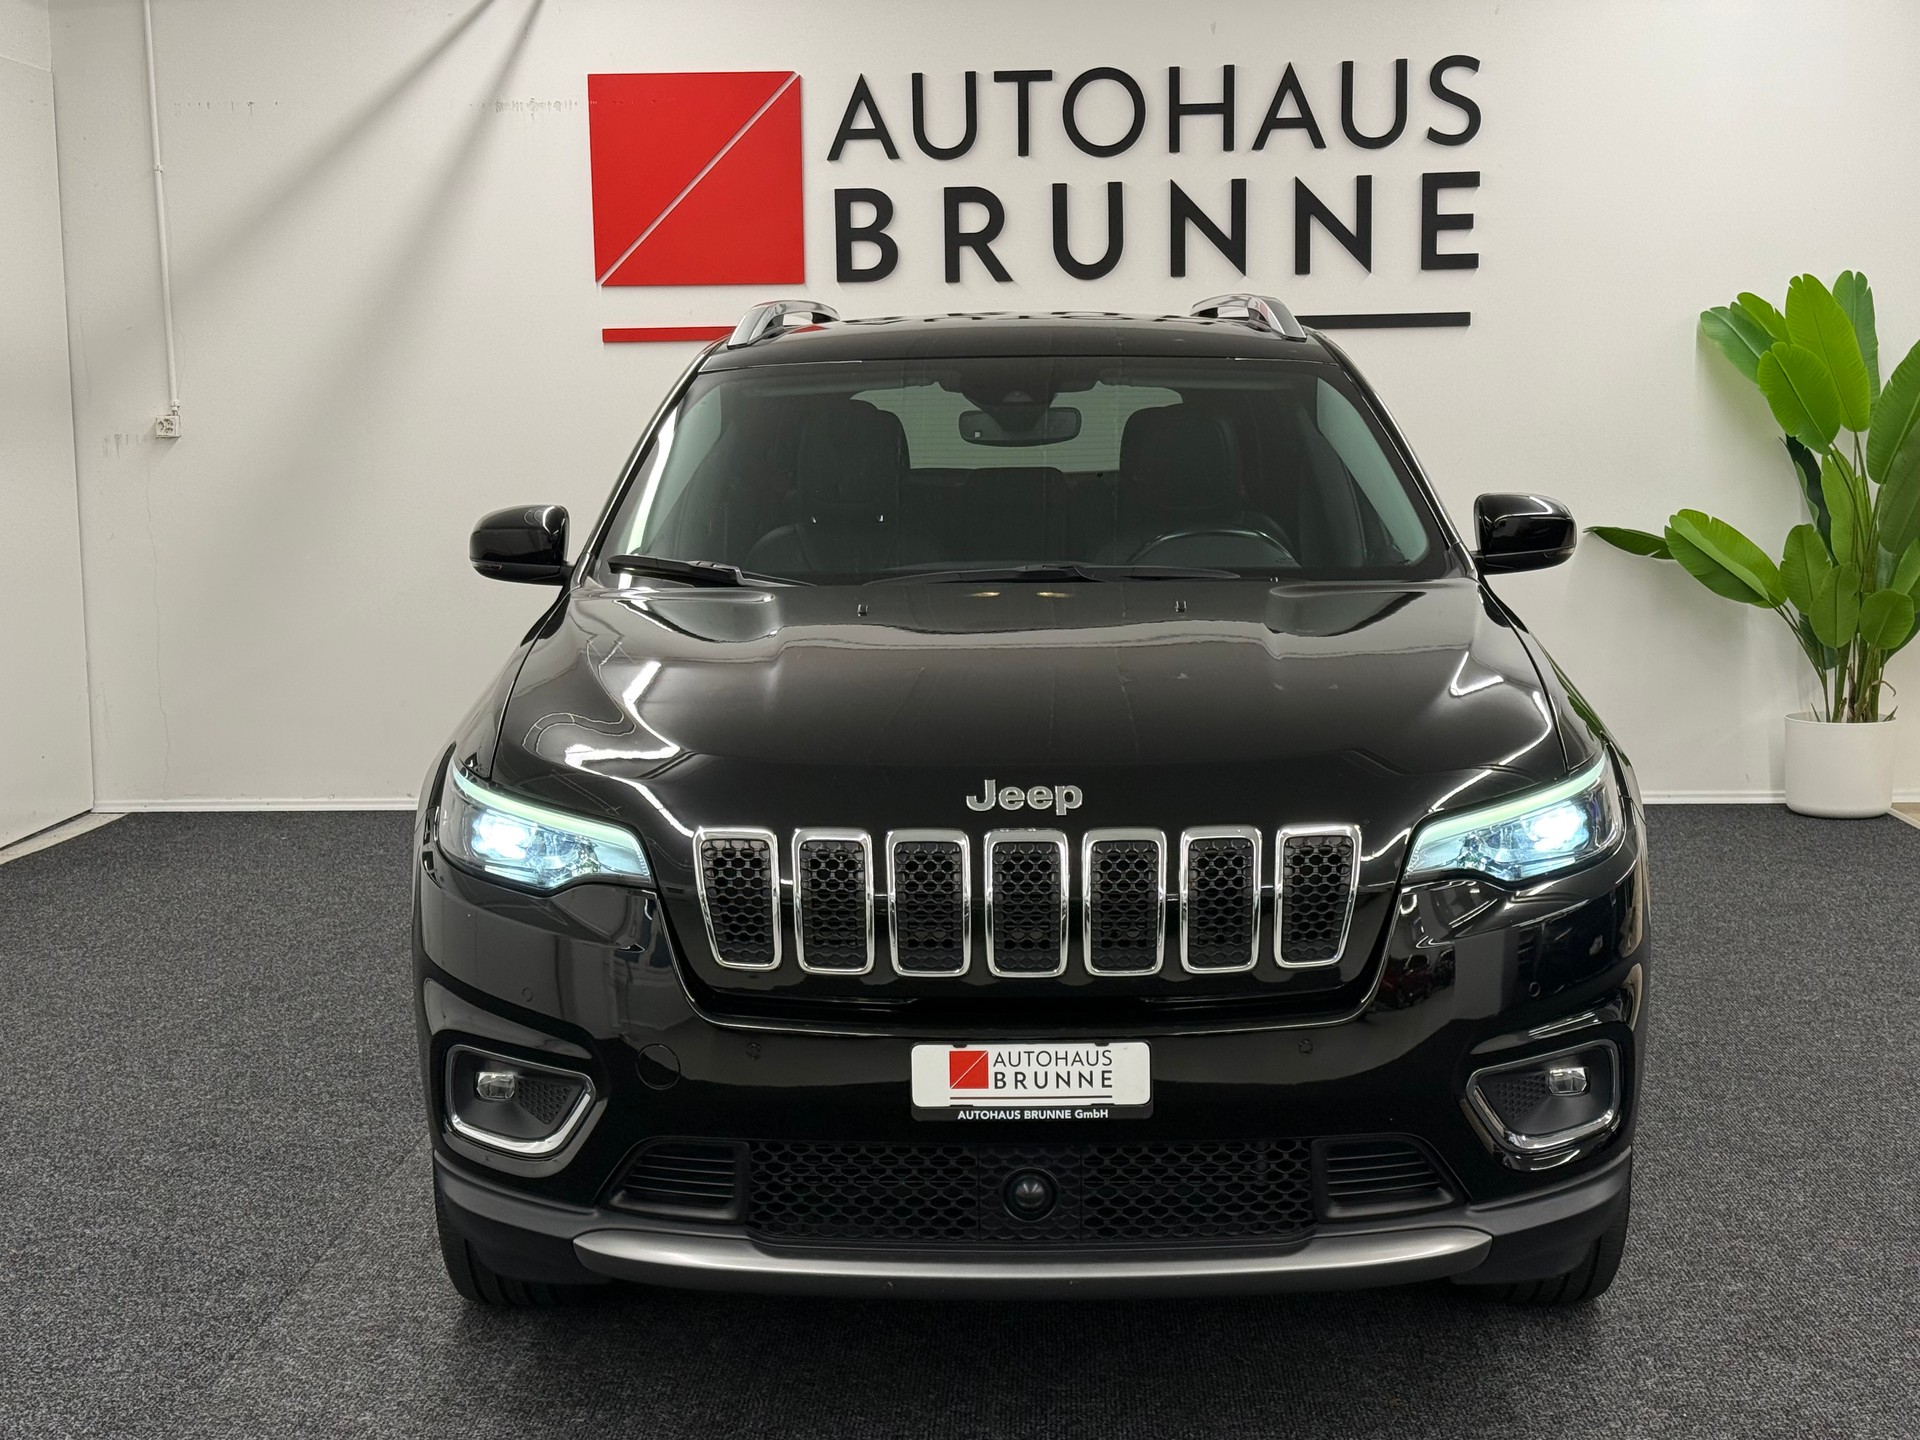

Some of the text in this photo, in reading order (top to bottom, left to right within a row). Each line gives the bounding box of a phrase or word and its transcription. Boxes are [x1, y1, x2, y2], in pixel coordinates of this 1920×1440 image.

[827, 54, 1482, 162] AUTOHAUS
[834, 170, 1482, 284] BRUNNE
[966, 779, 1083, 816] Jeep
[993, 1050, 1112, 1067] AUTOHAUS
[994, 1070, 1112, 1089] BRUNNE
[957, 1109, 1109, 1120] AUTOHAUS BRUNNE GmbH
